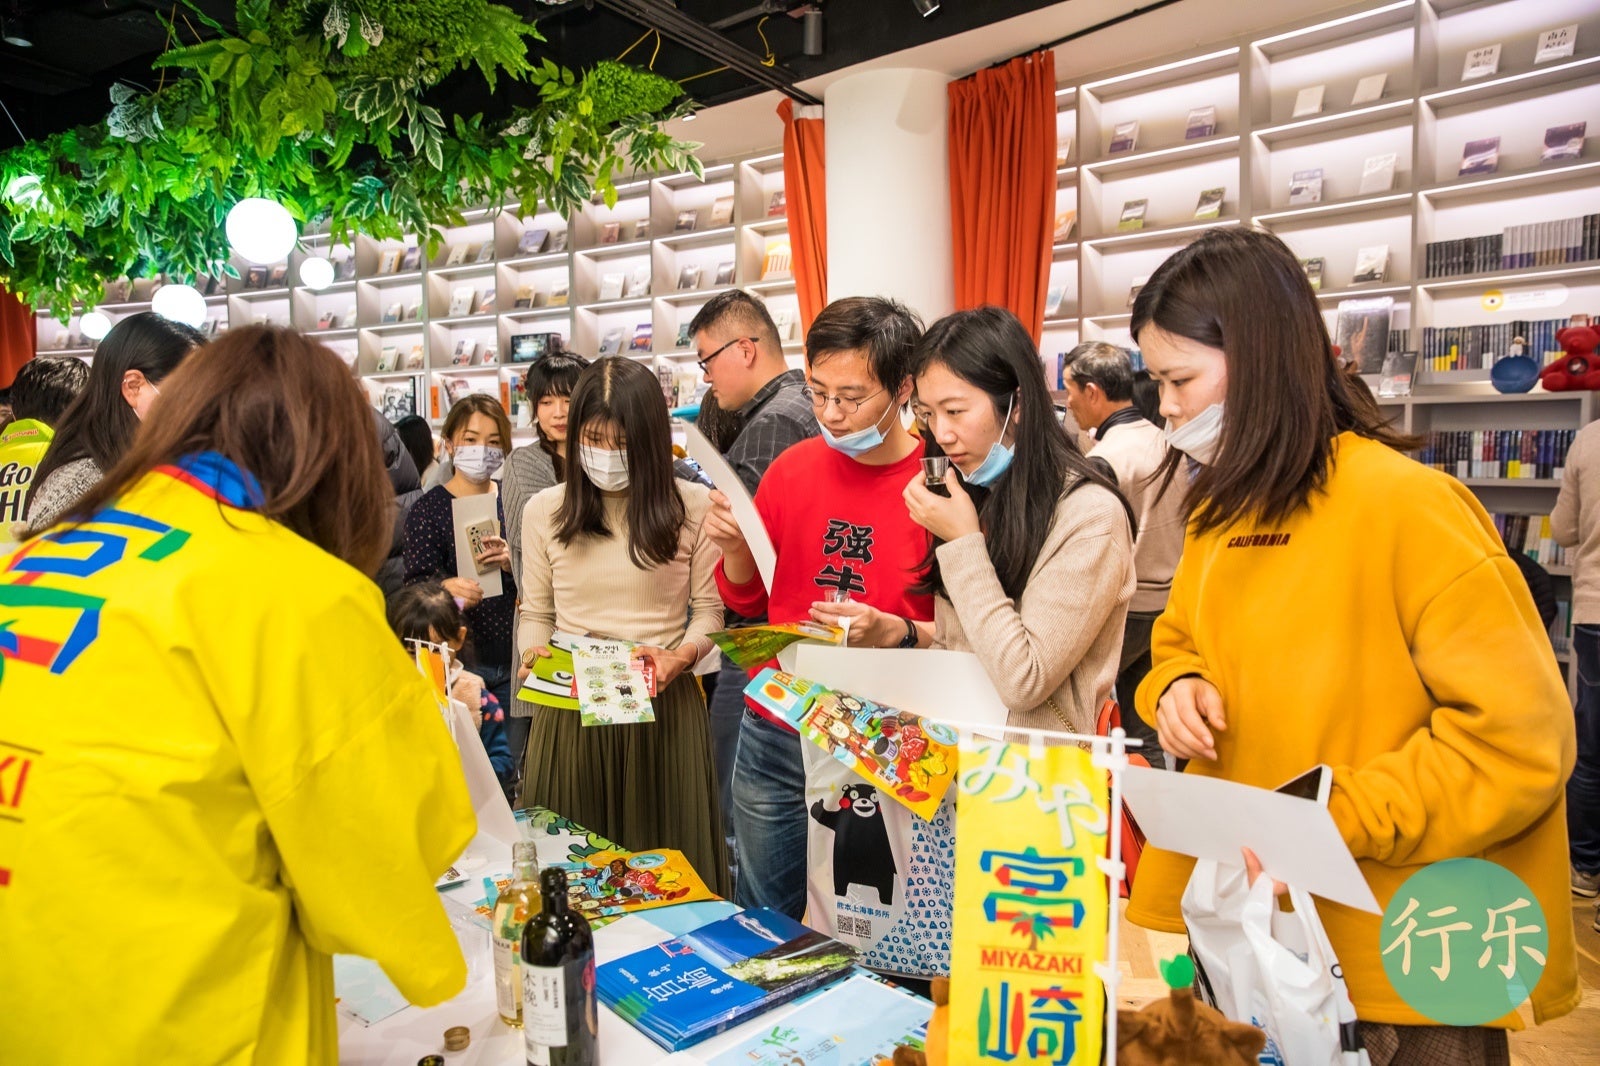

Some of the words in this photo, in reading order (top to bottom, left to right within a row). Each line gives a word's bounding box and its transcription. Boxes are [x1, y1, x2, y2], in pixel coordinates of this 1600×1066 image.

[1227, 534, 1291, 548] CALIFORNIA
[836, 901, 891, 919] 熊本上海事务所
[981, 950, 1083, 974] MIYAZAKI
